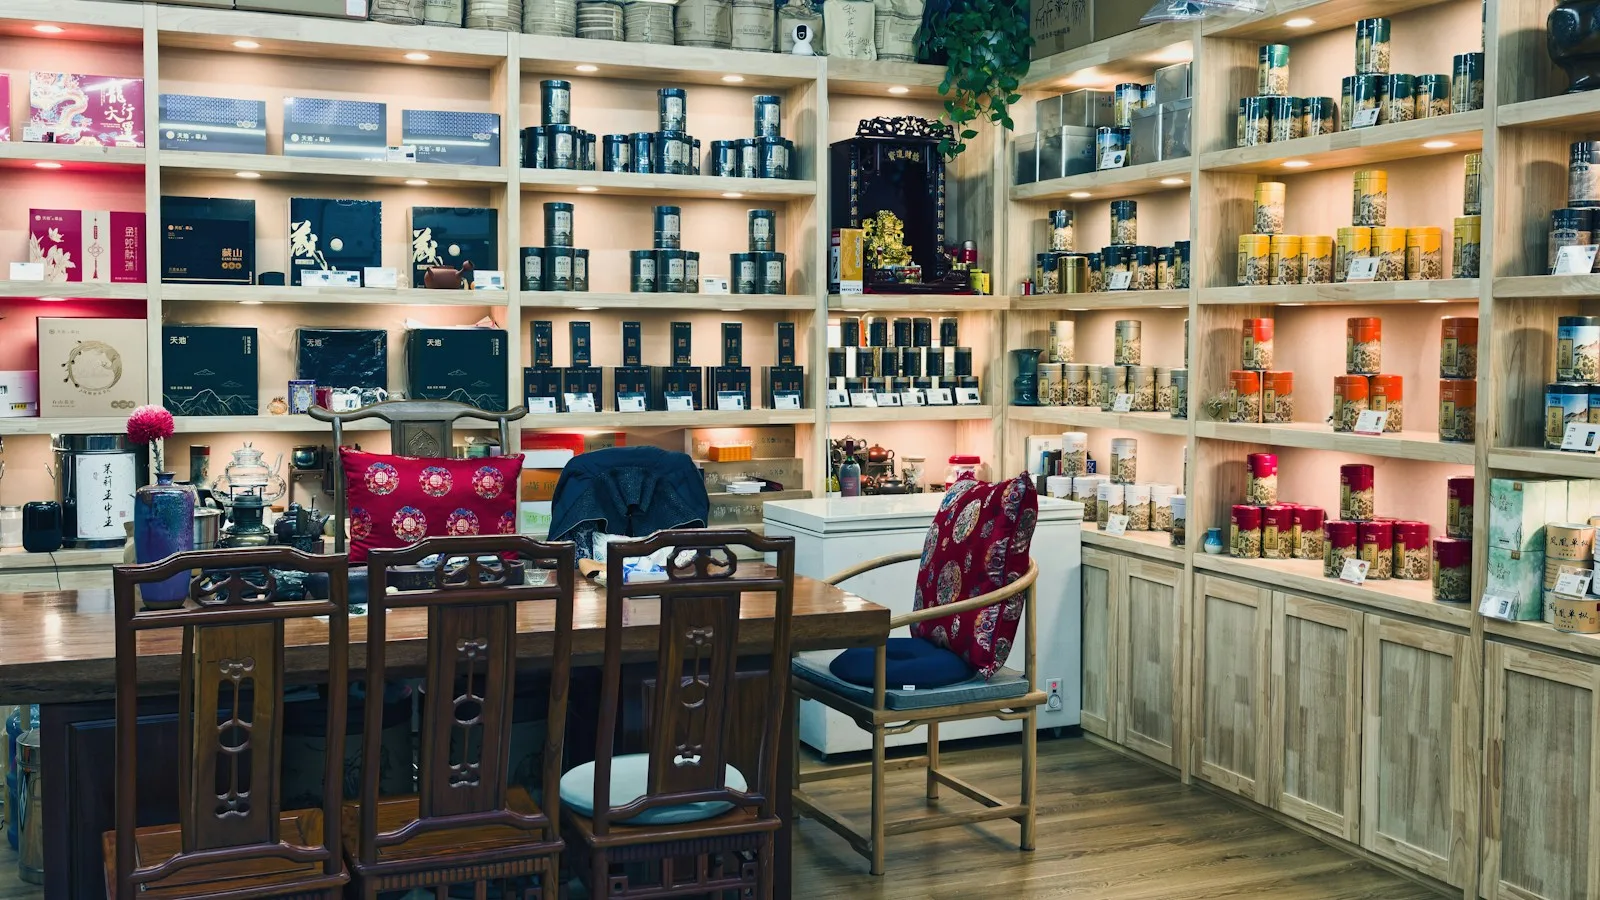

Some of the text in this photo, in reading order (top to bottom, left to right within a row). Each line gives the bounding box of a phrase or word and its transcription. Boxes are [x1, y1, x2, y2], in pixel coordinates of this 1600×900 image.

[169, 336, 187, 345] 天池
[426, 338, 442, 347] 天池
[103, 463, 113, 528] 茉莉王中王
